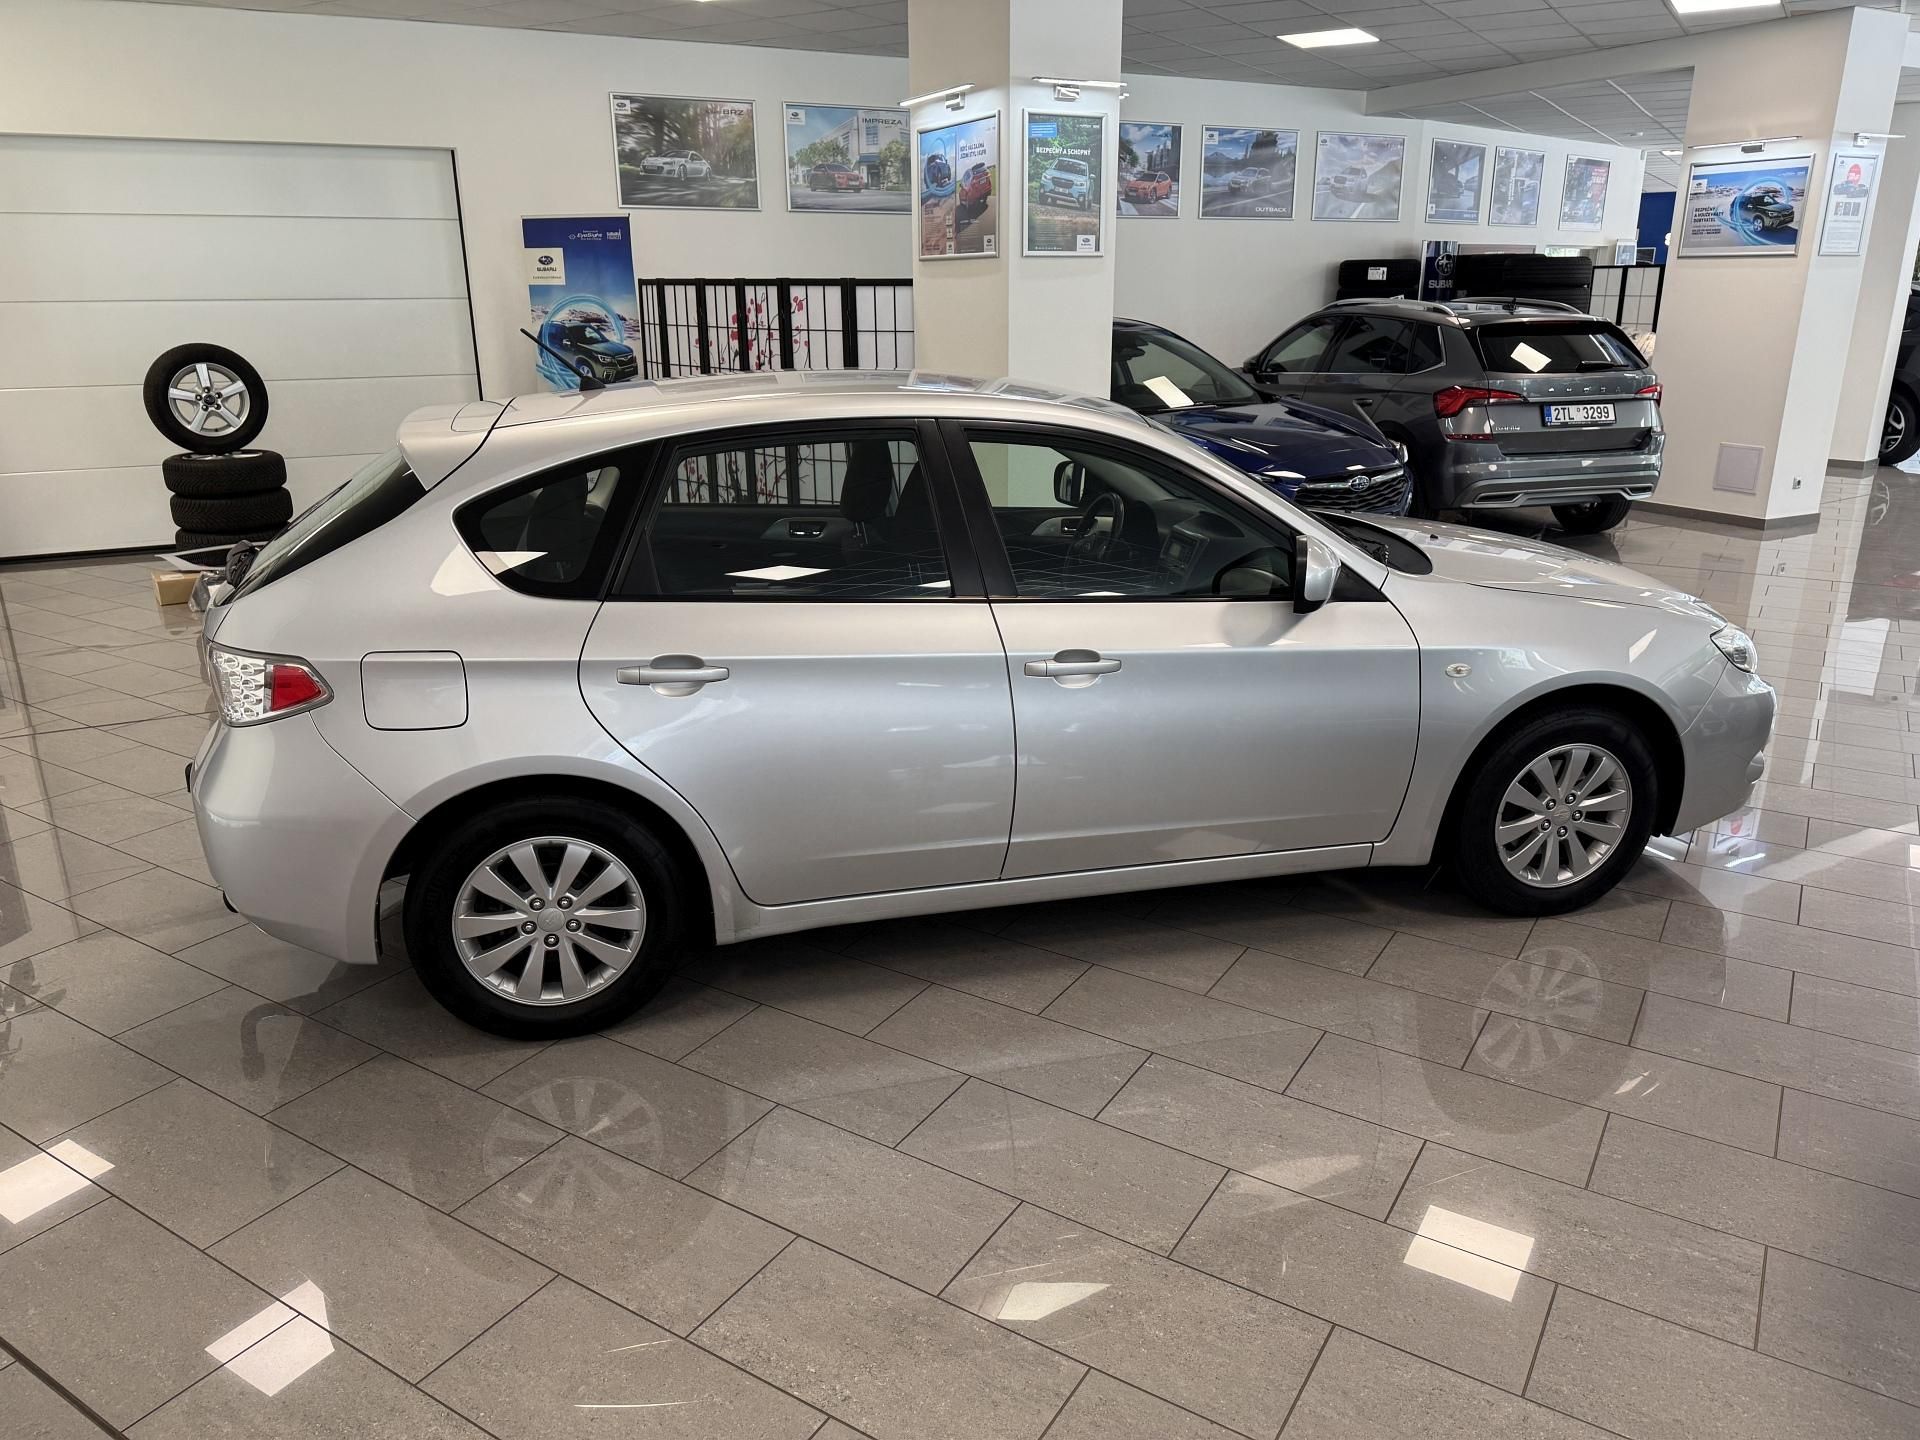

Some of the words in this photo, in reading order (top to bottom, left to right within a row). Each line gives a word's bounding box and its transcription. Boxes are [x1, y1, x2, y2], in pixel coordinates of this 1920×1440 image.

[862, 117, 902, 125] IMPREZA
[1554, 406, 1575, 421] 2TL
[1582, 405, 1610, 420] 3299
